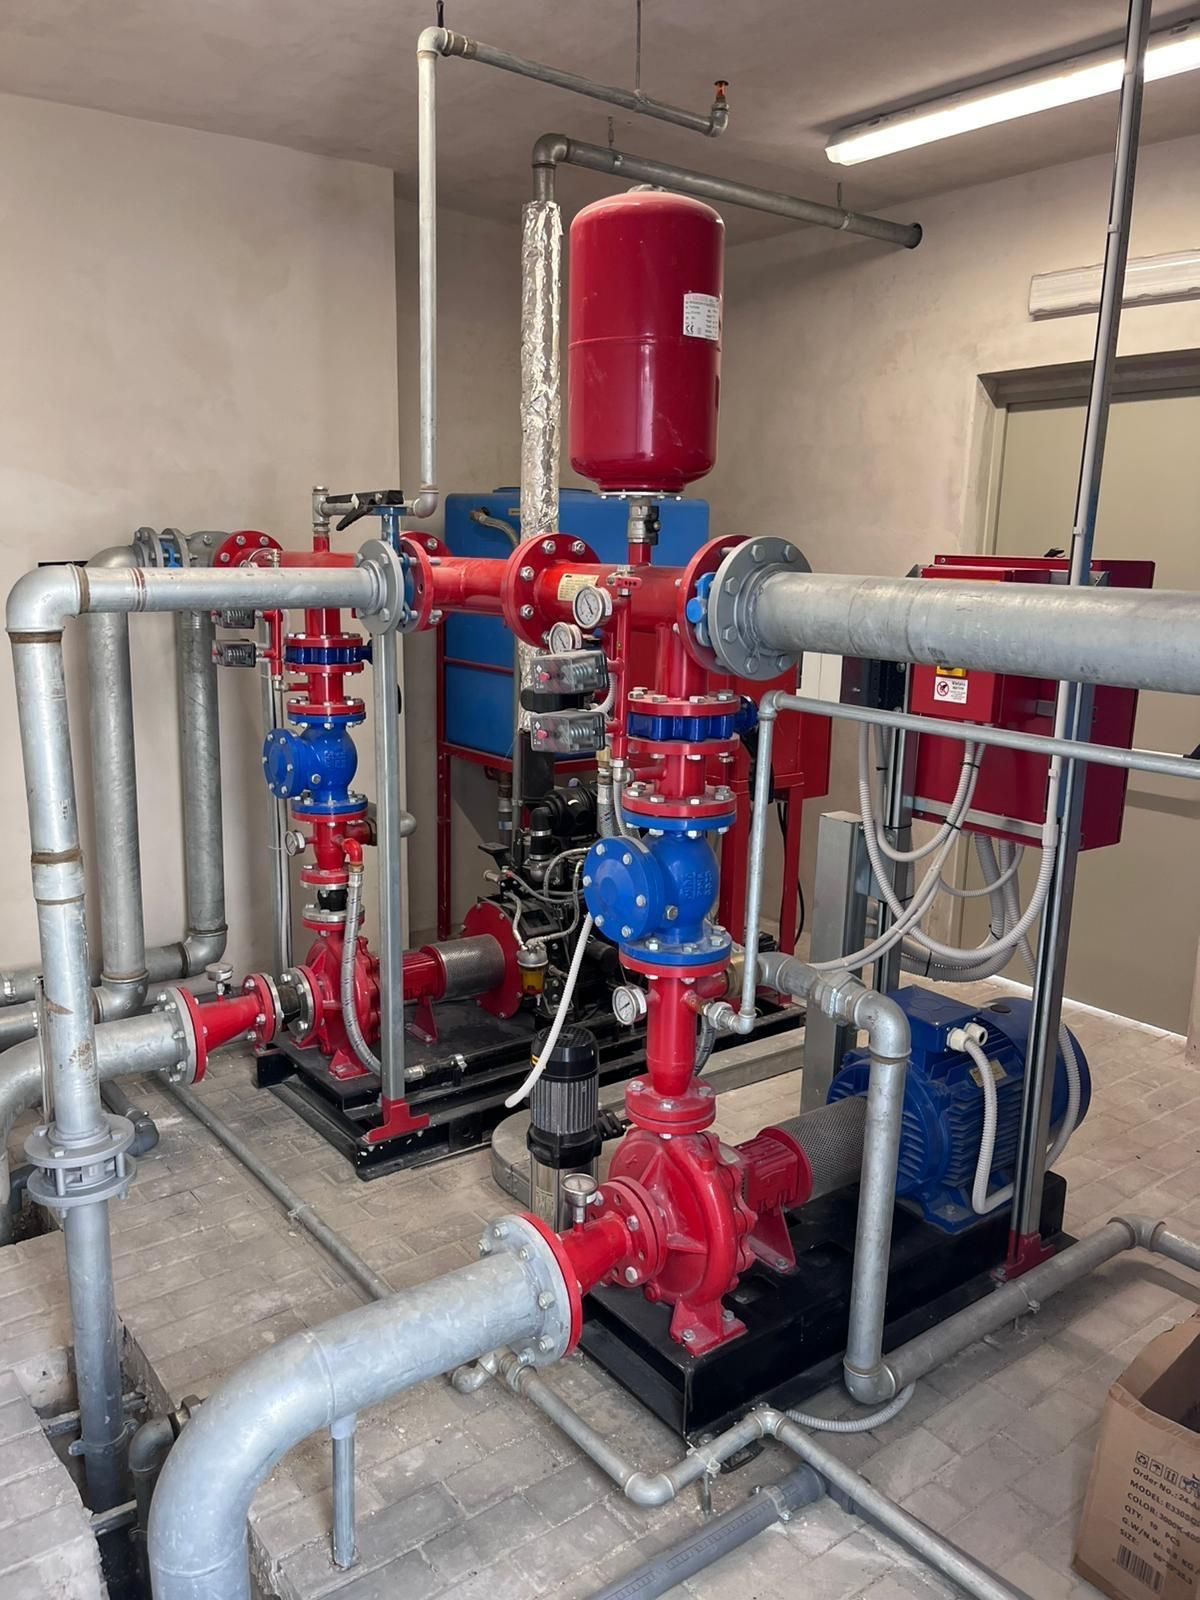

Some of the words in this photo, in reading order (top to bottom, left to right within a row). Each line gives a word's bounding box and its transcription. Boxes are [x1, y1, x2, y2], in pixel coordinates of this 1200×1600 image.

[1133, 1467, 1158, 1486] Order
[1130, 1479, 1164, 1505] MODEL:
[1124, 1504, 1143, 1520] QTY:
[1165, 1532, 1180, 1547] PCS
